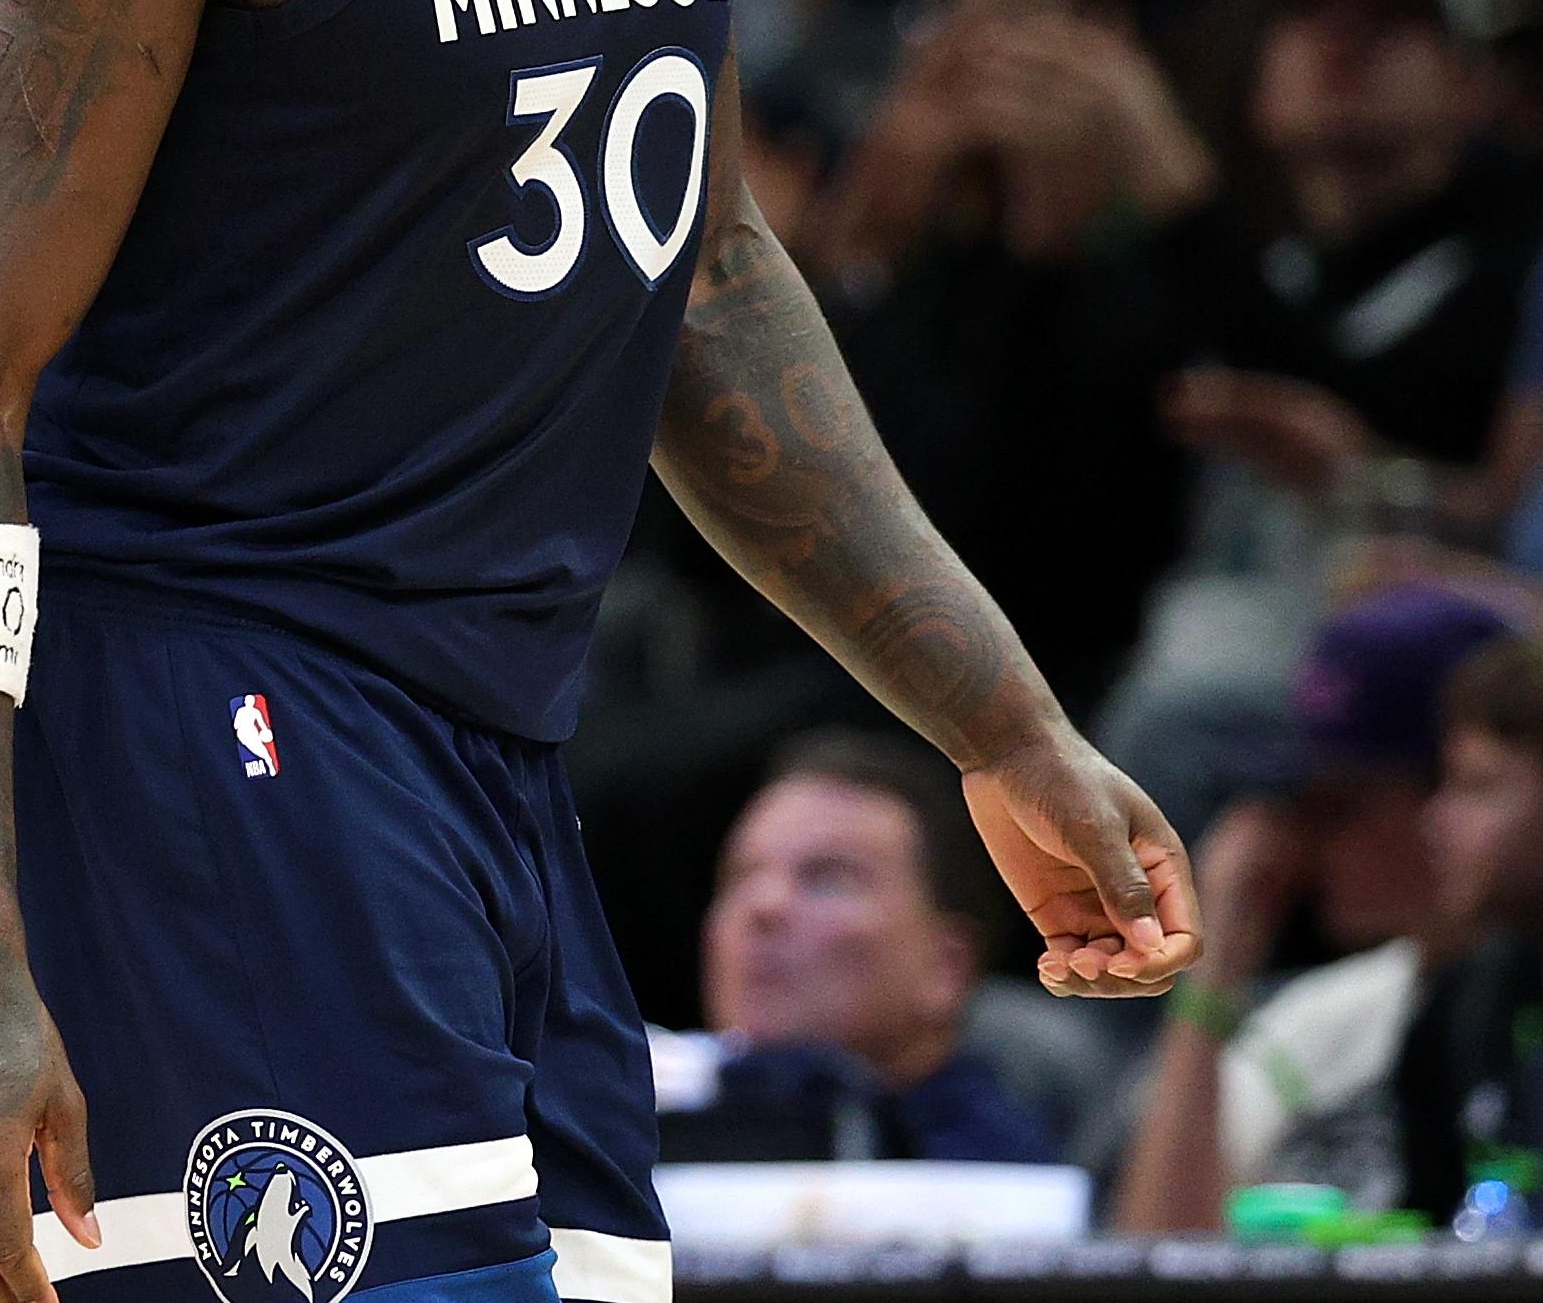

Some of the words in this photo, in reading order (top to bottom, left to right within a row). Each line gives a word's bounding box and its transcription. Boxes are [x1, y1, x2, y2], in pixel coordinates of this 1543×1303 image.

[467, 46, 710, 302] 30
[245, 759, 267, 778] NBA
[188, 1127, 240, 1260] MINNESOTA
[250, 1121, 363, 1283] TIMBERWOLVES
